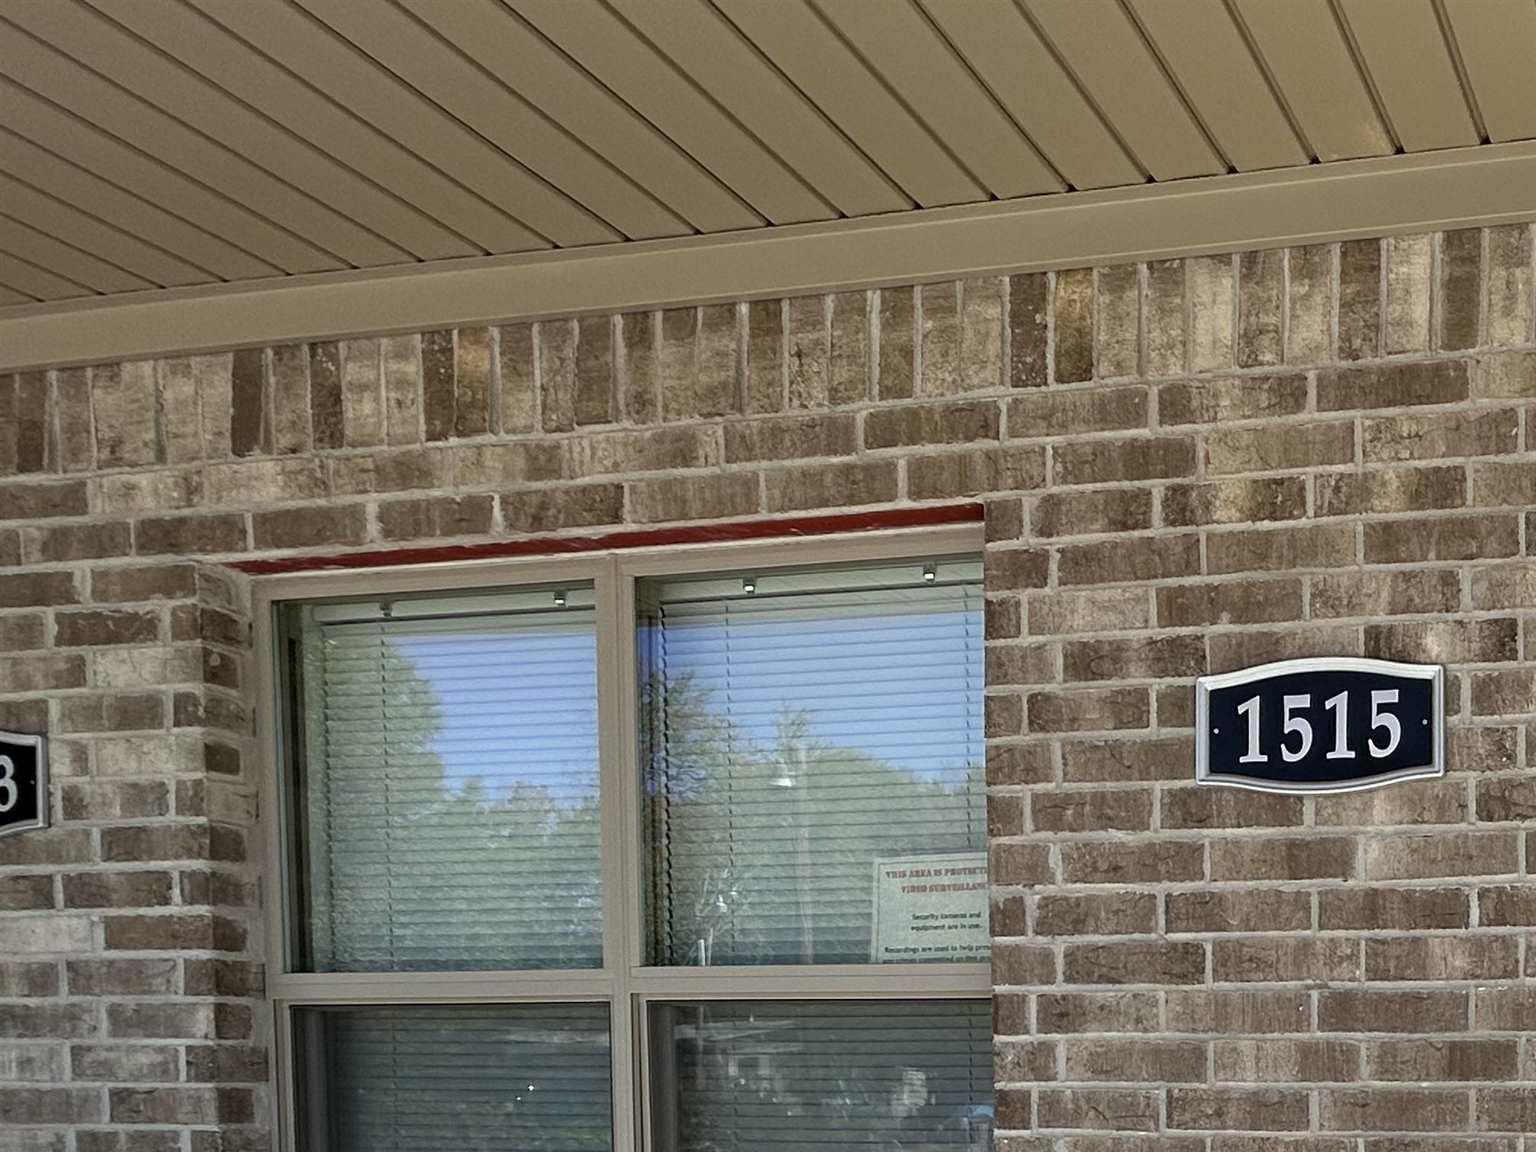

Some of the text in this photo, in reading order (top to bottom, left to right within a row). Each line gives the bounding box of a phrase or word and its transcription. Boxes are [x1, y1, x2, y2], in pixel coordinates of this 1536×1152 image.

[1237, 689, 1402, 763] 1515
[909, 869, 931, 877] AREA
[933, 869, 943, 877] IS
[901, 885, 928, 894] VIDEO
[912, 913, 939, 921] Security
